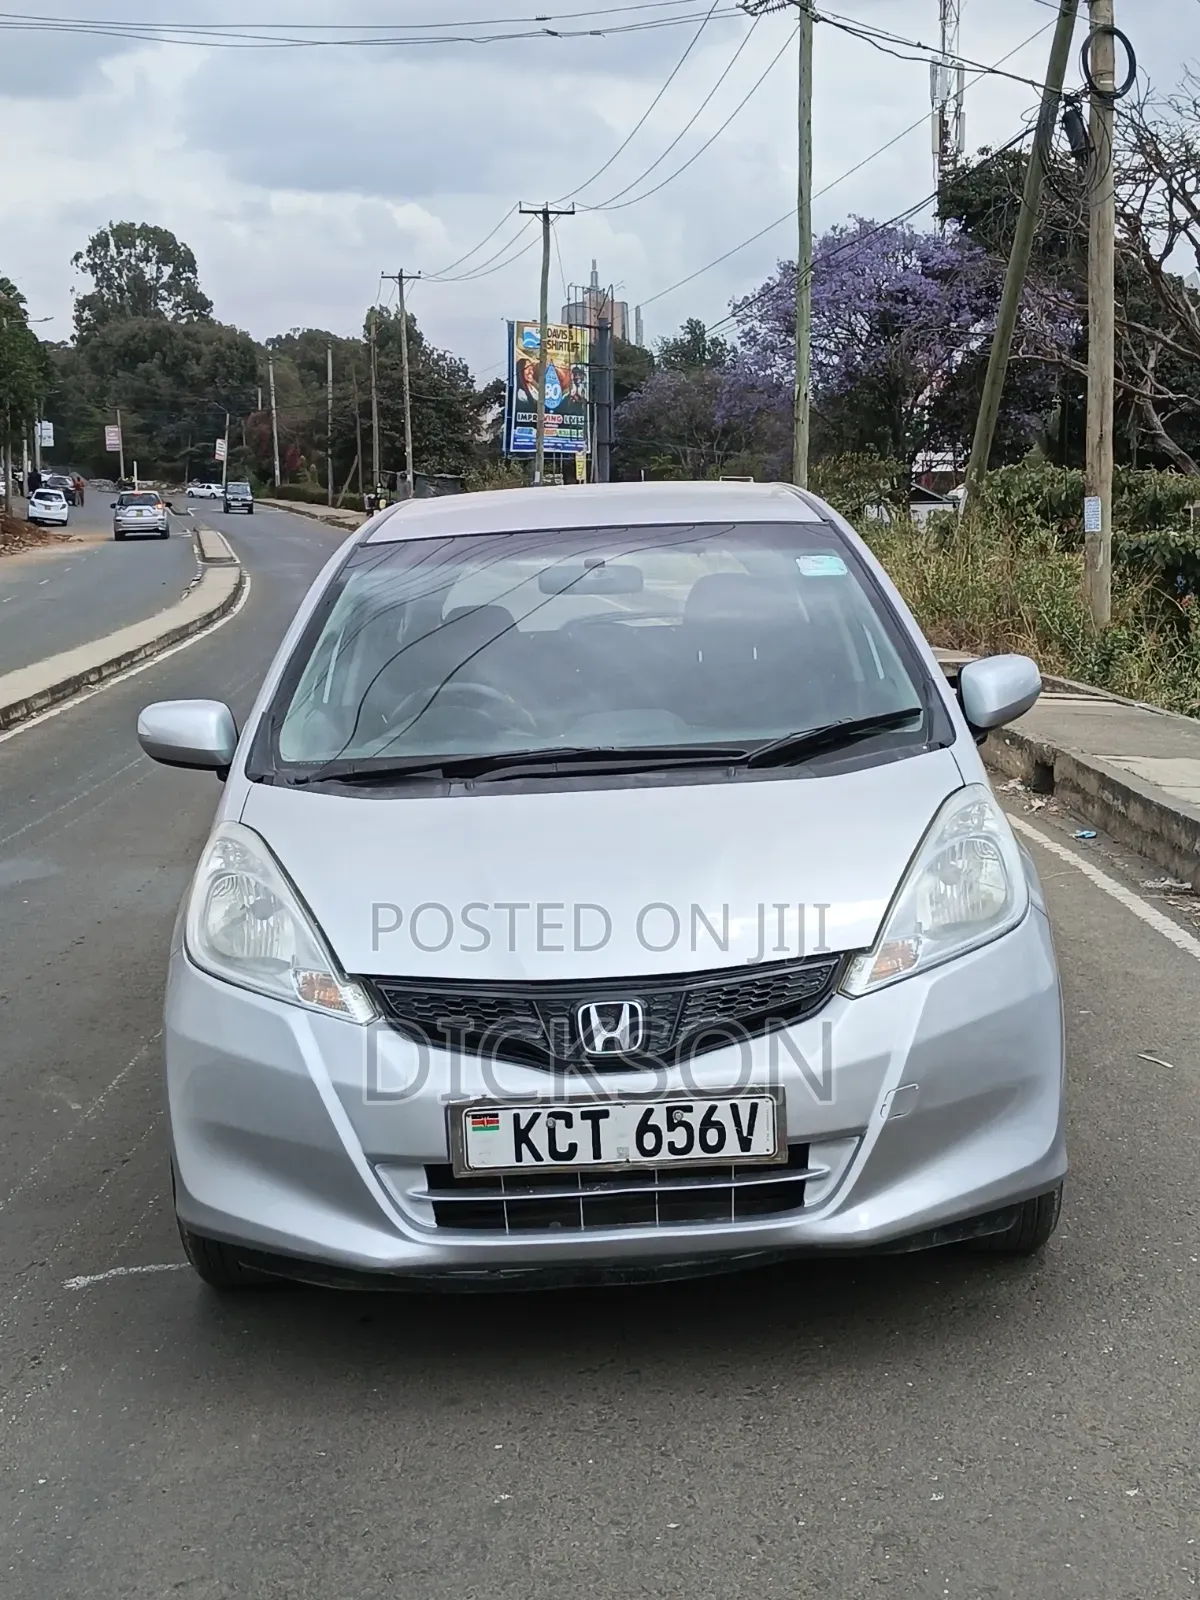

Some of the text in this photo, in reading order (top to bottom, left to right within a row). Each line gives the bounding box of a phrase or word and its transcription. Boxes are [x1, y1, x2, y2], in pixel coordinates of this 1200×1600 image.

[547, 328, 568, 340] DAVIS
[545, 383, 562, 400] 80
[517, 412, 562, 424] IMPRVING
[512, 1108, 610, 1163] KCT
[635, 1102, 759, 1158] 656V
